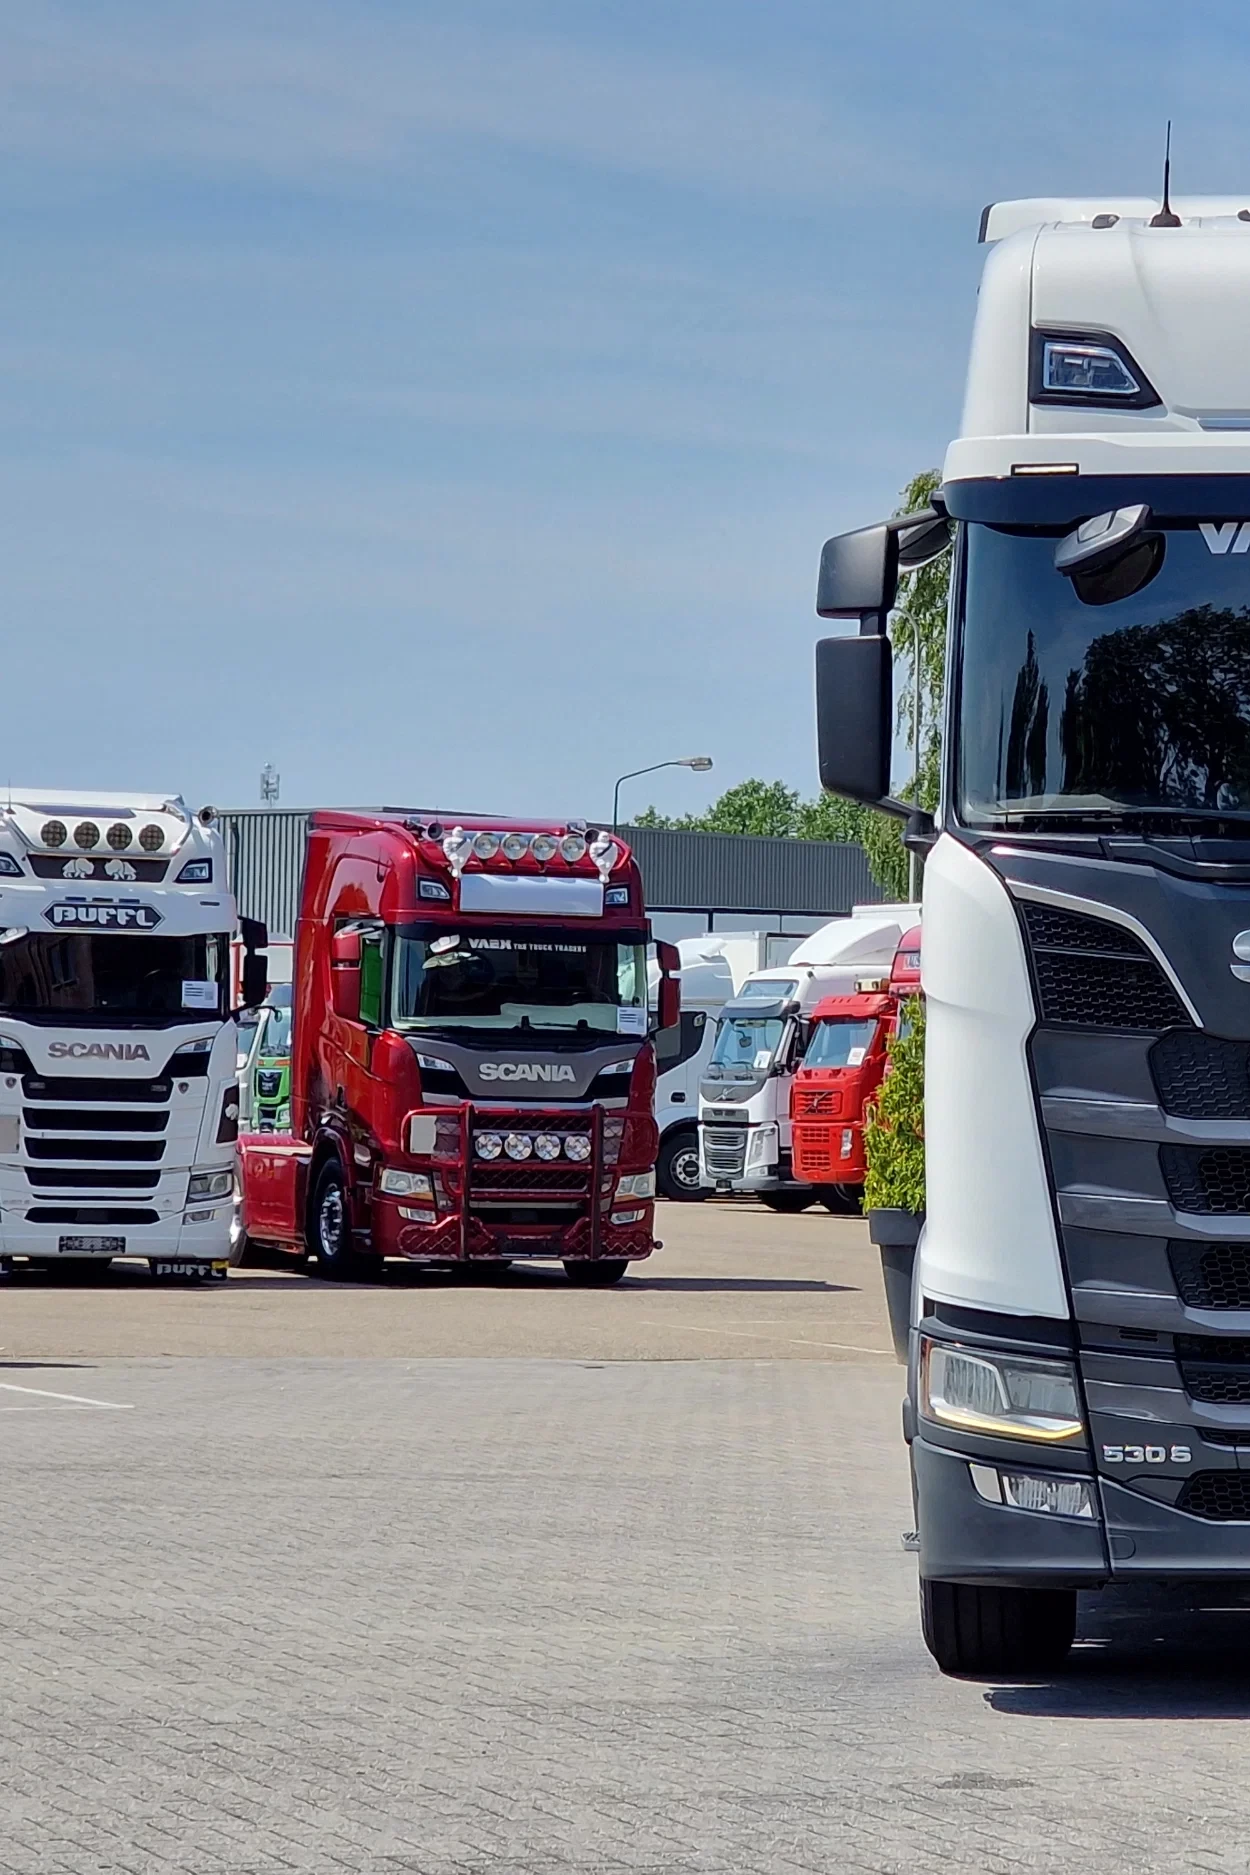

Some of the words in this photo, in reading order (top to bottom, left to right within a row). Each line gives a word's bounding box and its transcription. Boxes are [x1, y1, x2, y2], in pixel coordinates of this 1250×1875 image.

[53, 906, 154, 926] BUFFL
[529, 943, 553, 951] TRUCK
[555, 944, 586, 952] TRADERS
[47, 1041, 151, 1061] SCANIA
[479, 1063, 576, 1082] SCANIA
[1103, 1445, 1166, 1463] 530
[1170, 1445, 1192, 1463] S
